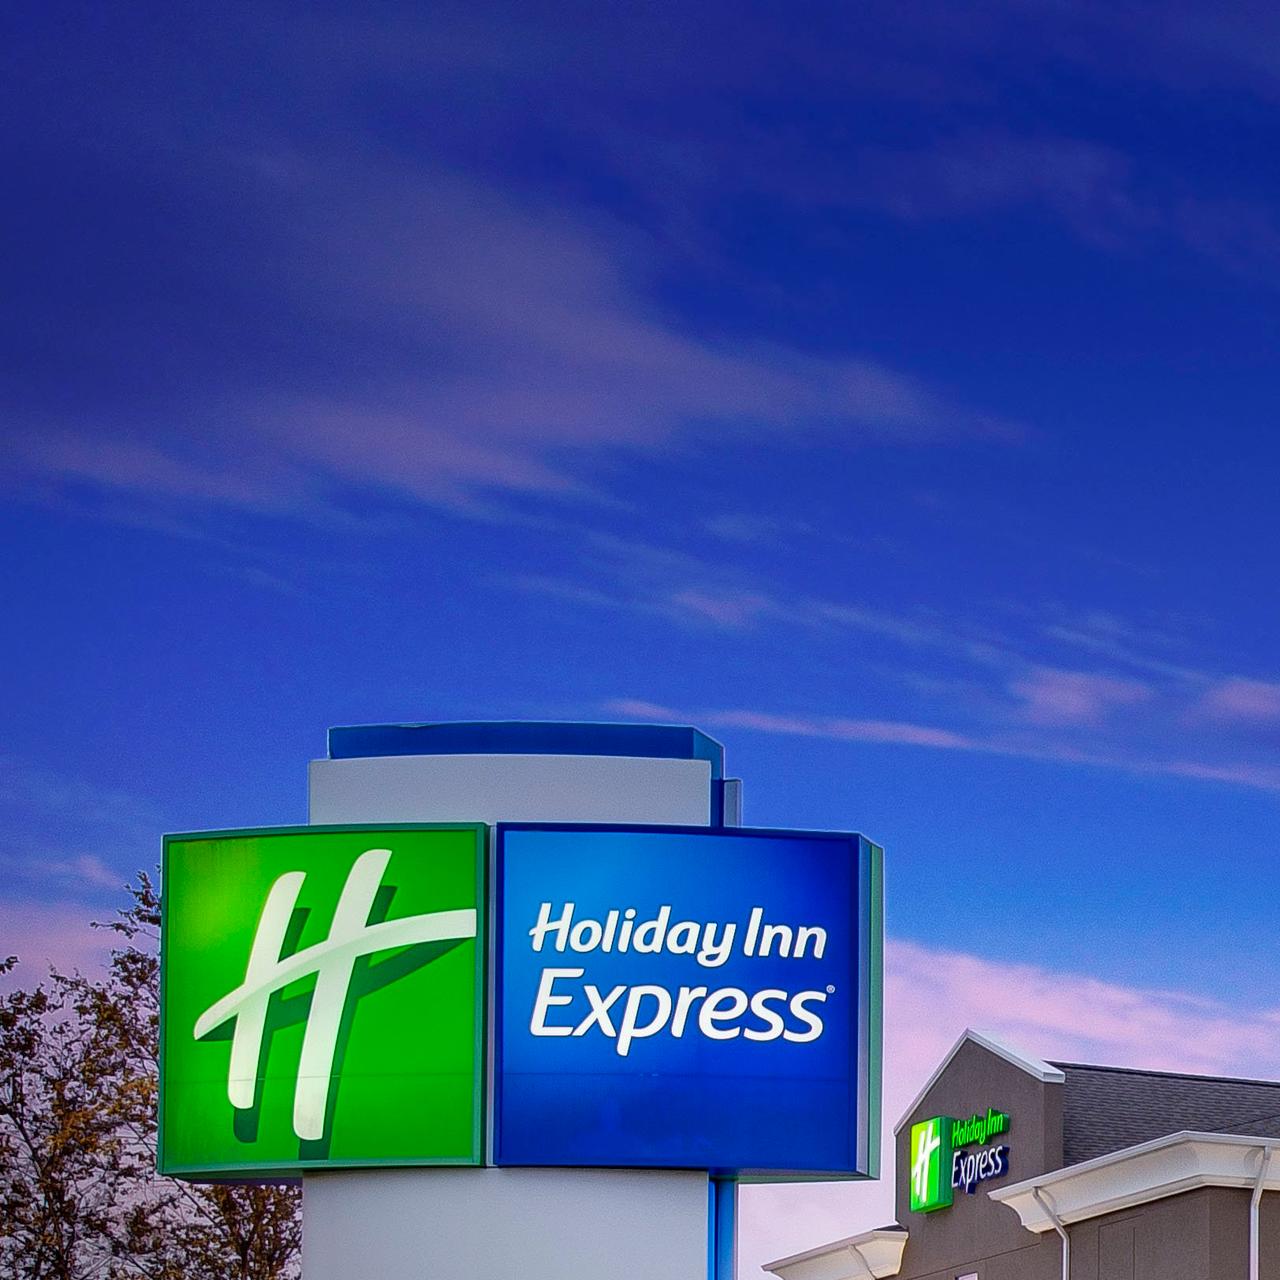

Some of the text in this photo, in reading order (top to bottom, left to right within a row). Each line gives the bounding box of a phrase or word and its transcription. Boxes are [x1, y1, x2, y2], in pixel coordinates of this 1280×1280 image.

[528, 902, 828, 966] Holiday Inn
[193, 849, 477, 1141] H
[952, 1108, 1004, 1147] Holiday Inn
[951, 1145, 1003, 1192] Express
